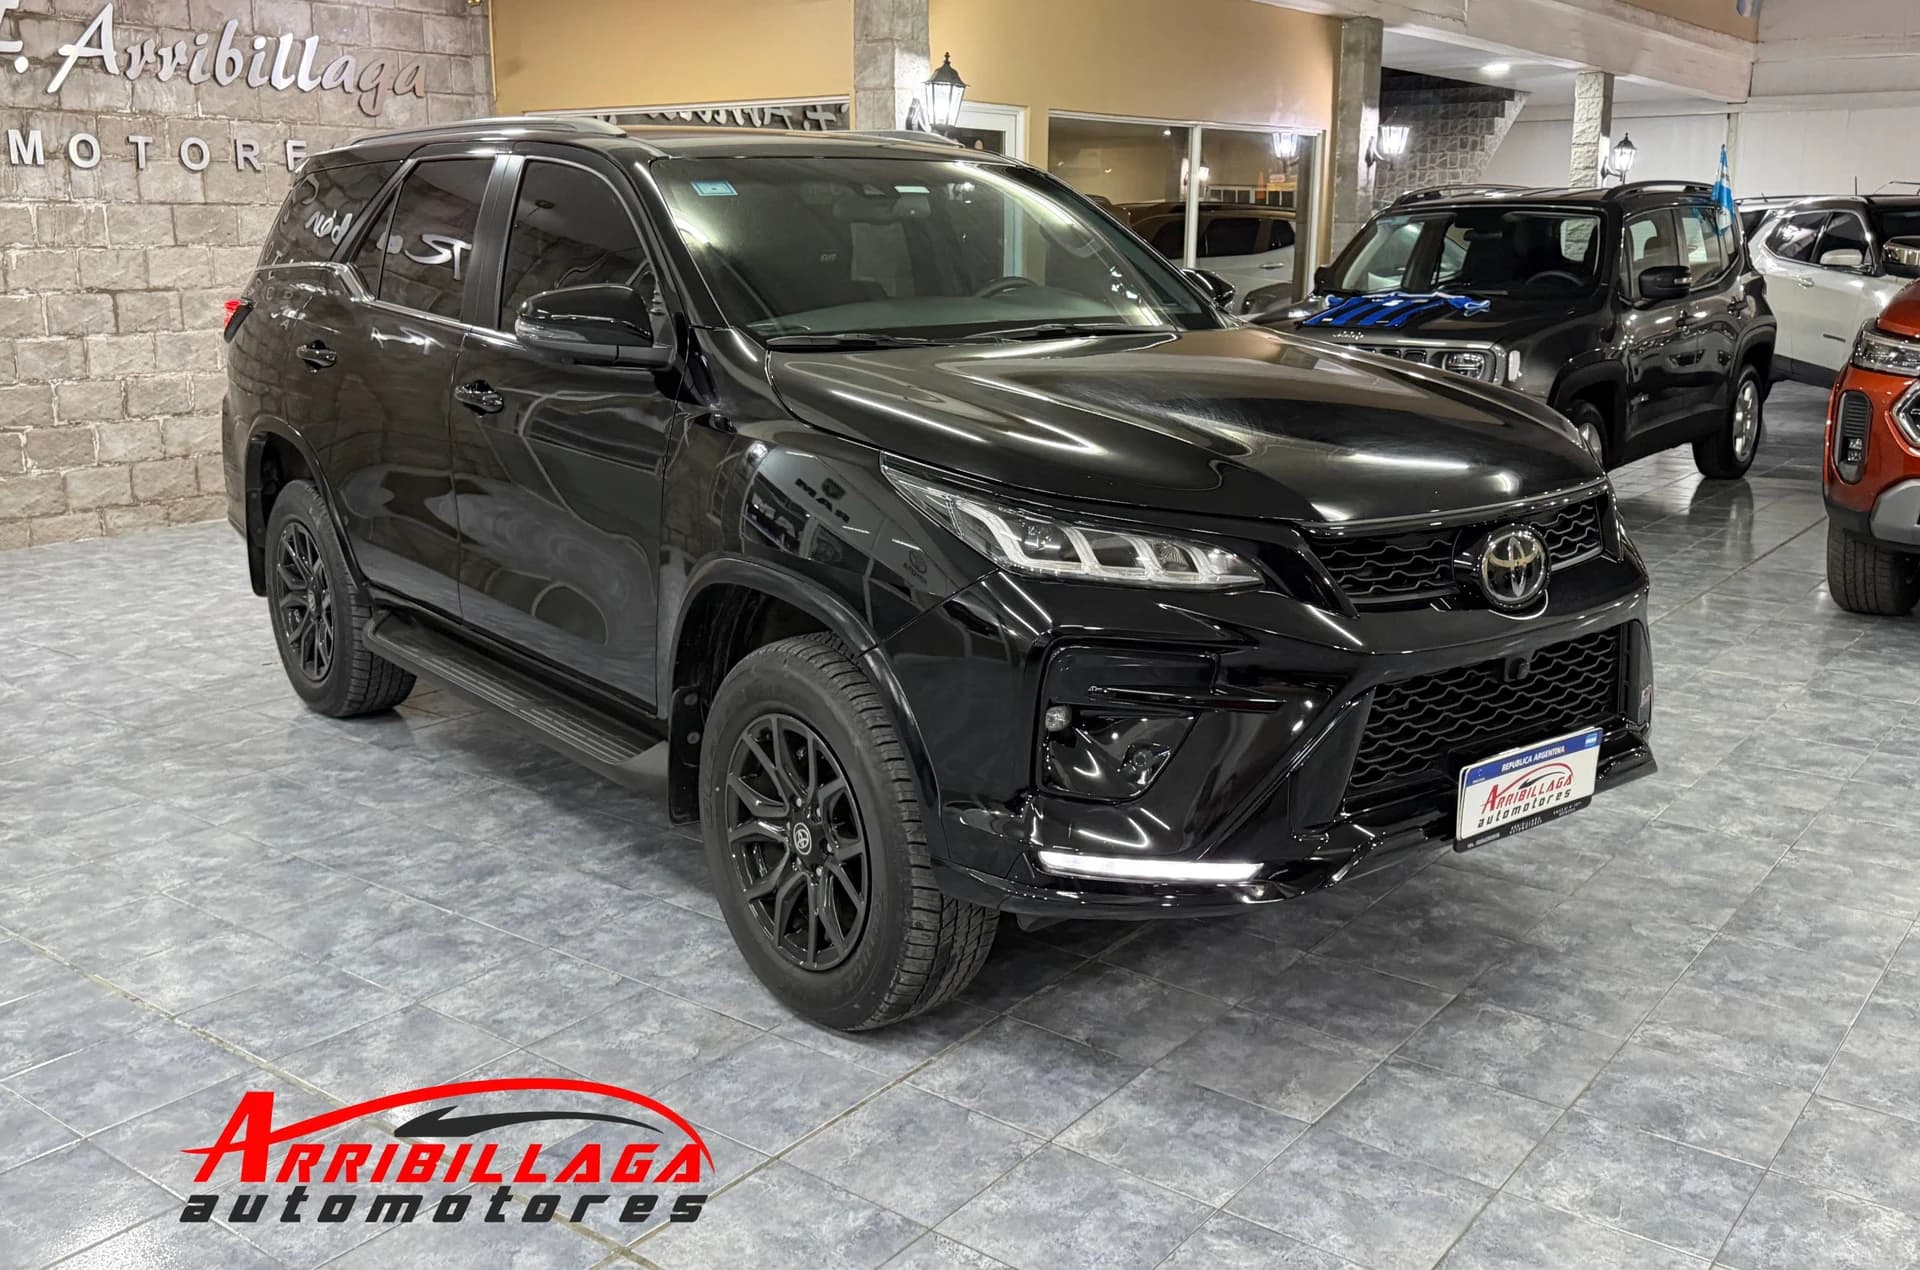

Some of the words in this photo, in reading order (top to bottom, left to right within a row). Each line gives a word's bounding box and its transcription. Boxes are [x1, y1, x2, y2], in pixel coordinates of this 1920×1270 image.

[46, 2, 426, 117] Arribillaga
[1477, 788, 1572, 828] automotores
[1481, 774, 1573, 815] ARRIBILLAGA
